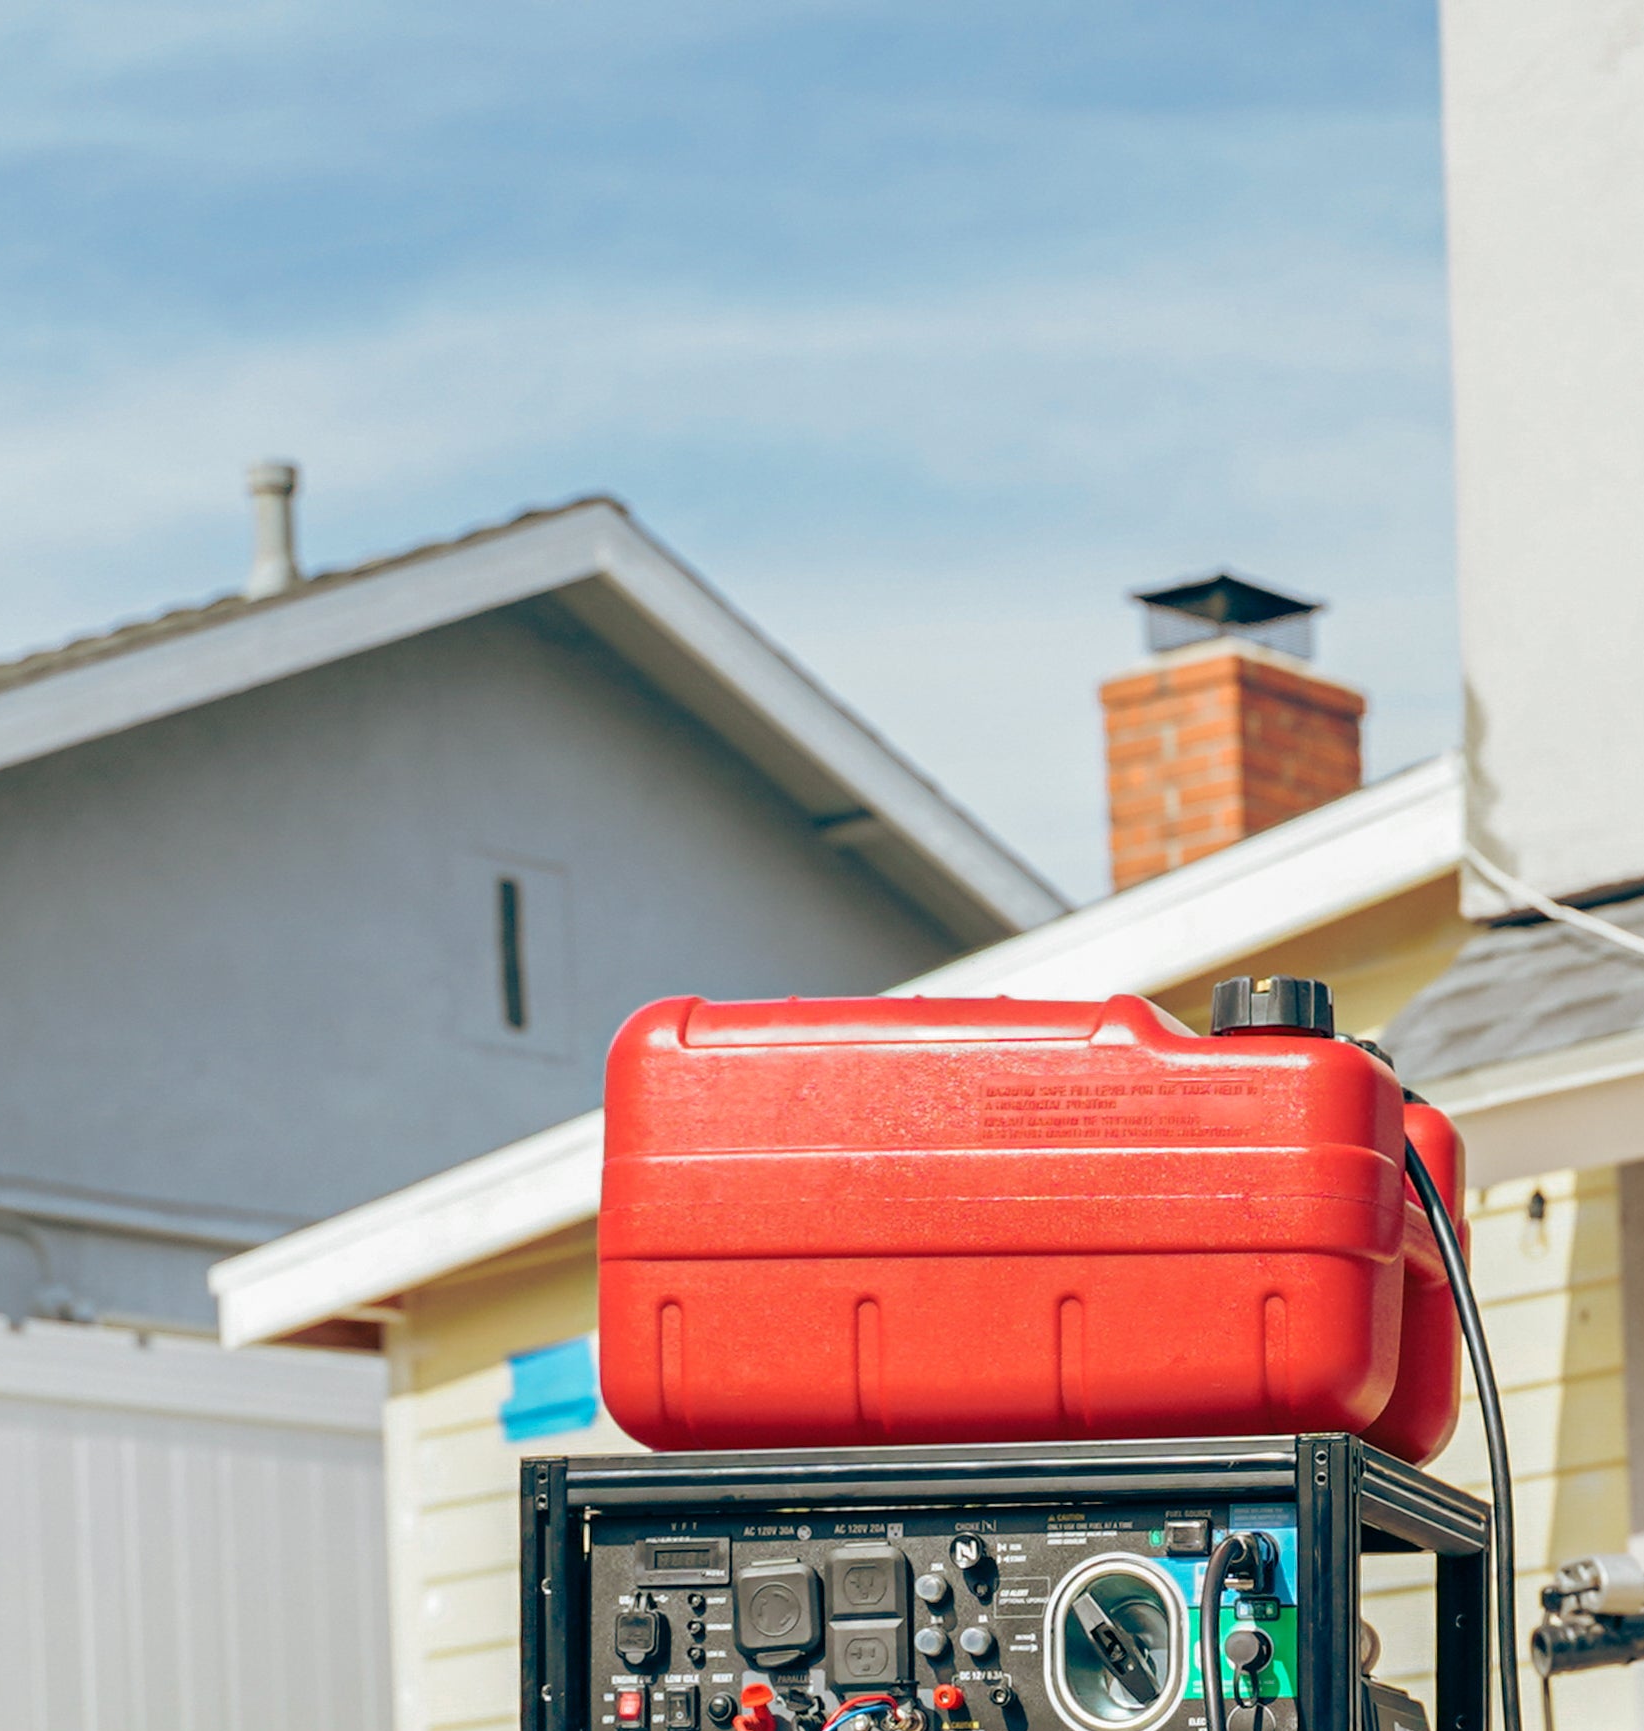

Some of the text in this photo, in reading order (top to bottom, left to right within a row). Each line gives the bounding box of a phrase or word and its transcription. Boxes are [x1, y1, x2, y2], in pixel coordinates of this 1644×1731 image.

[743, 1527, 755, 1536] AC
[757, 1526, 778, 1536] 120V
[834, 1524, 847, 1534] AC
[848, 1524, 868, 1534] 120V
[711, 1673, 734, 1683] RESET
